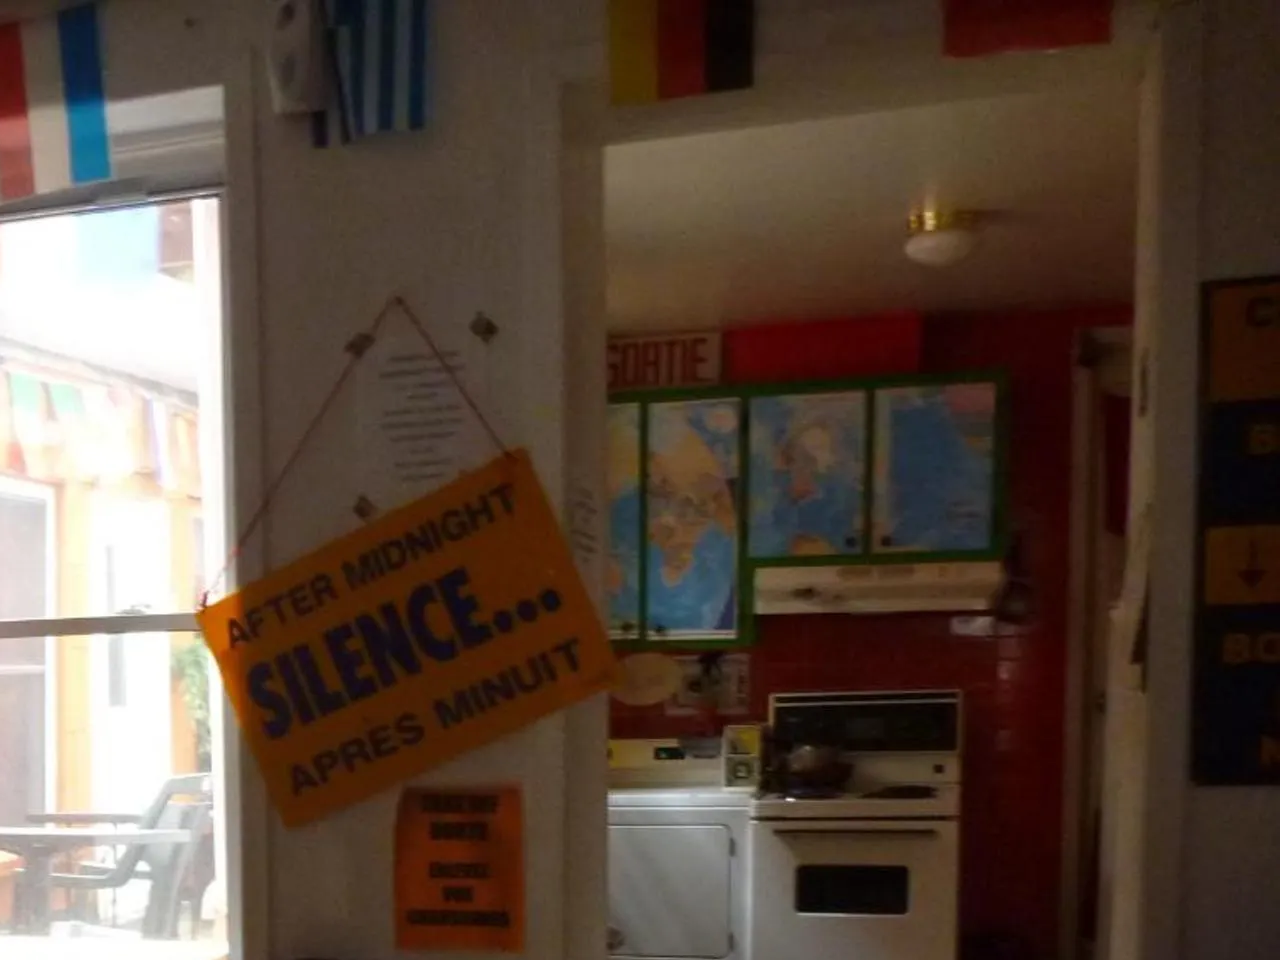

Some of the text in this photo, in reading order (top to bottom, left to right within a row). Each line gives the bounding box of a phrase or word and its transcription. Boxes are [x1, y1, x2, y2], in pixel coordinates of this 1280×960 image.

[227, 574, 341, 650] AFTER
[340, 482, 518, 592] MIDNIGHT
[246, 566, 563, 740] SILENCE...
[433, 637, 580, 731] MINUIT
